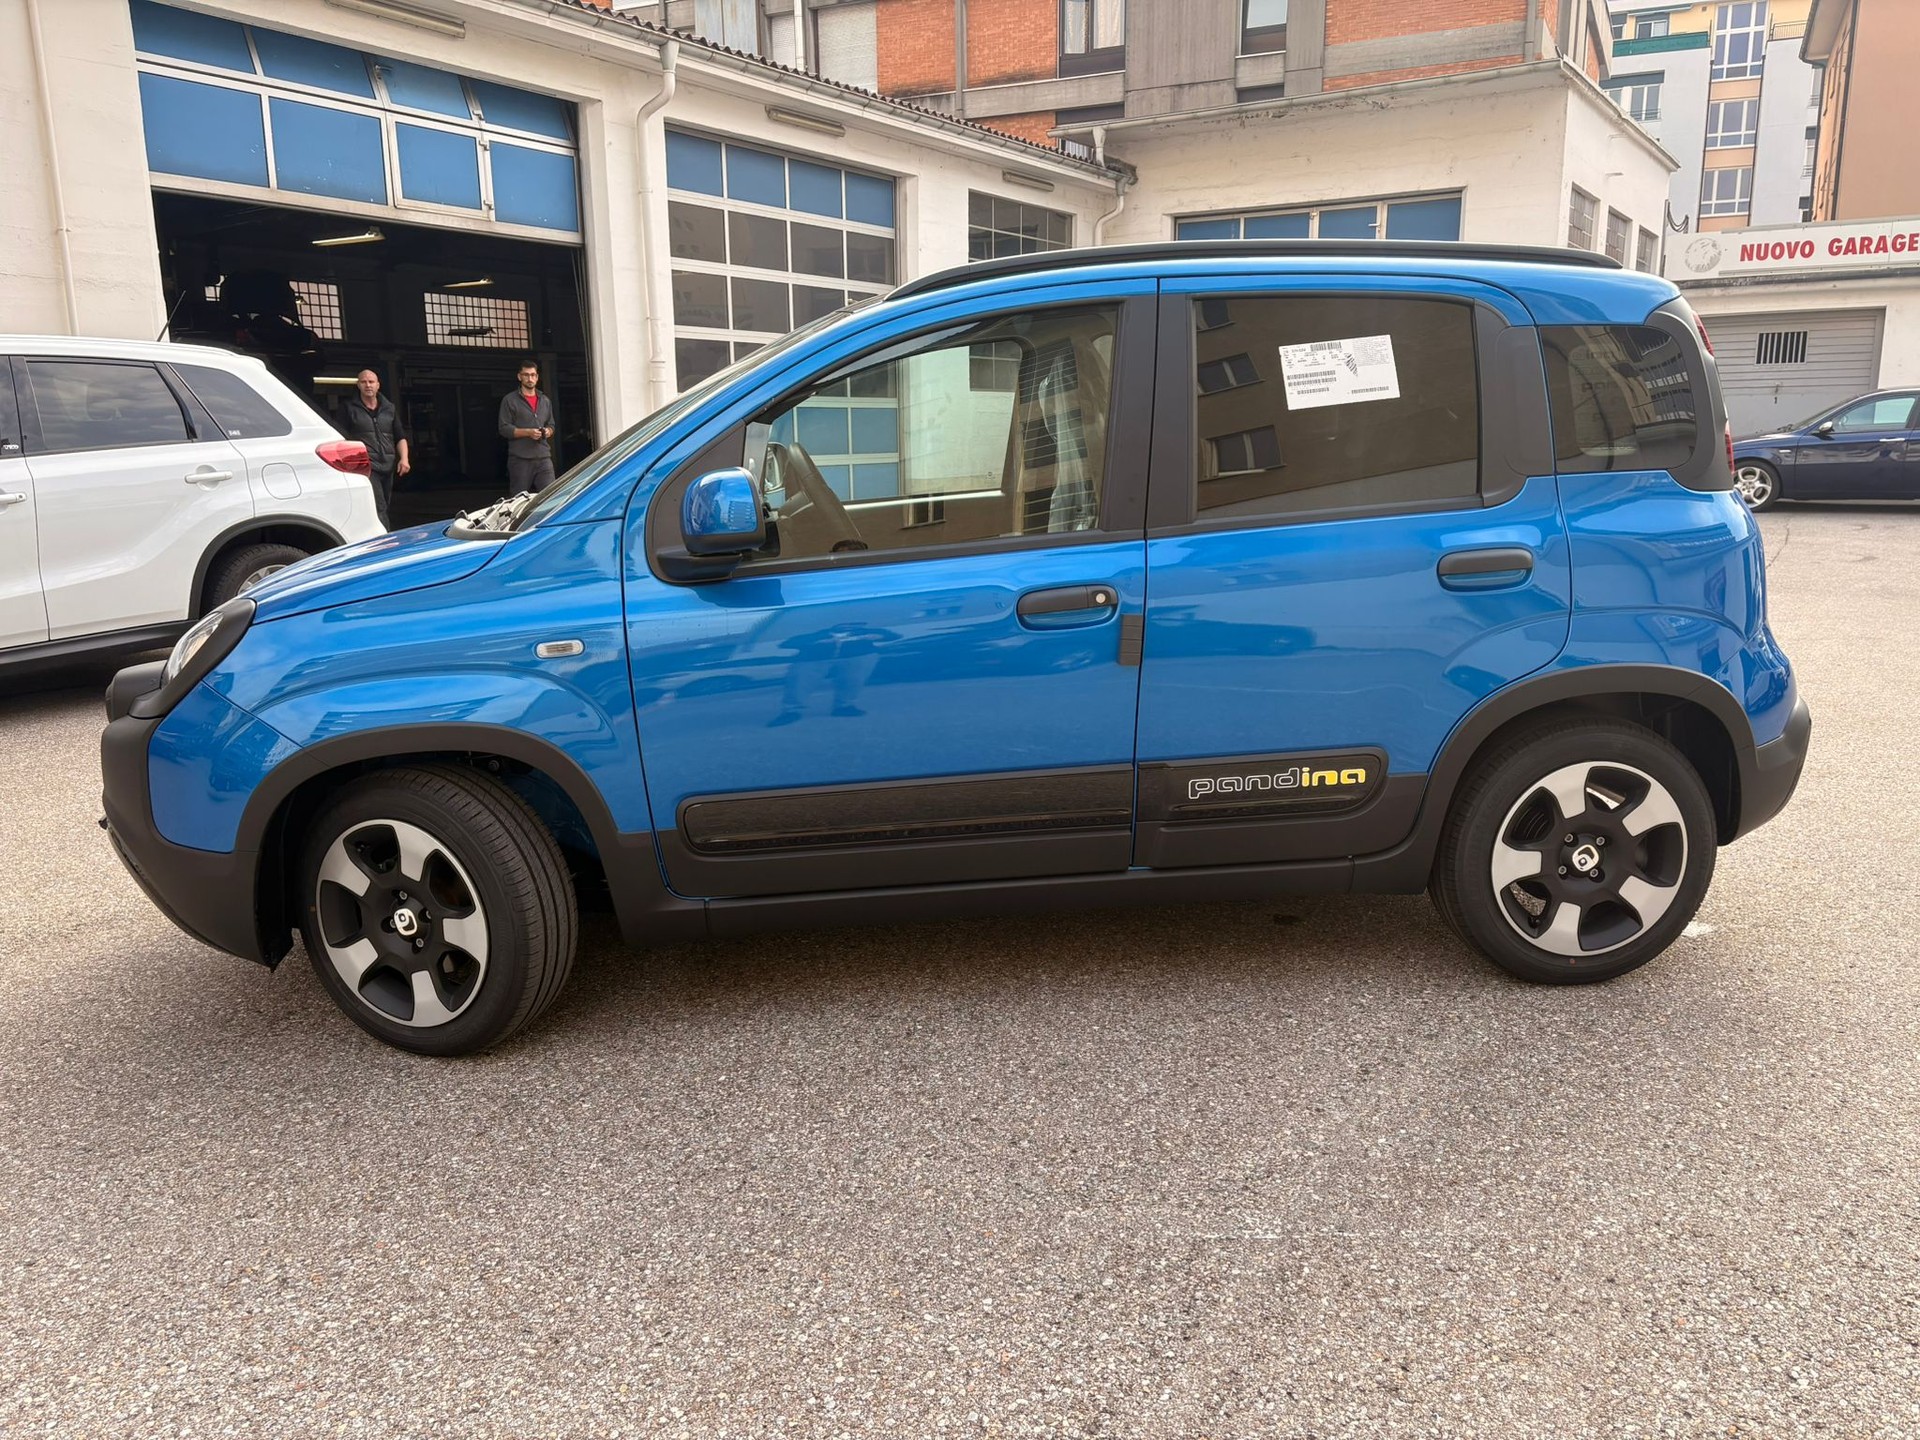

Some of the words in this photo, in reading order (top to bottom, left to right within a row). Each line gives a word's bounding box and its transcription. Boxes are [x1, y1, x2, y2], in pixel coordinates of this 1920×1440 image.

[1739, 240, 1816, 262] NUOVO
[1827, 233, 1920, 257] GARAGE
[1188, 767, 1366, 800] pandina
